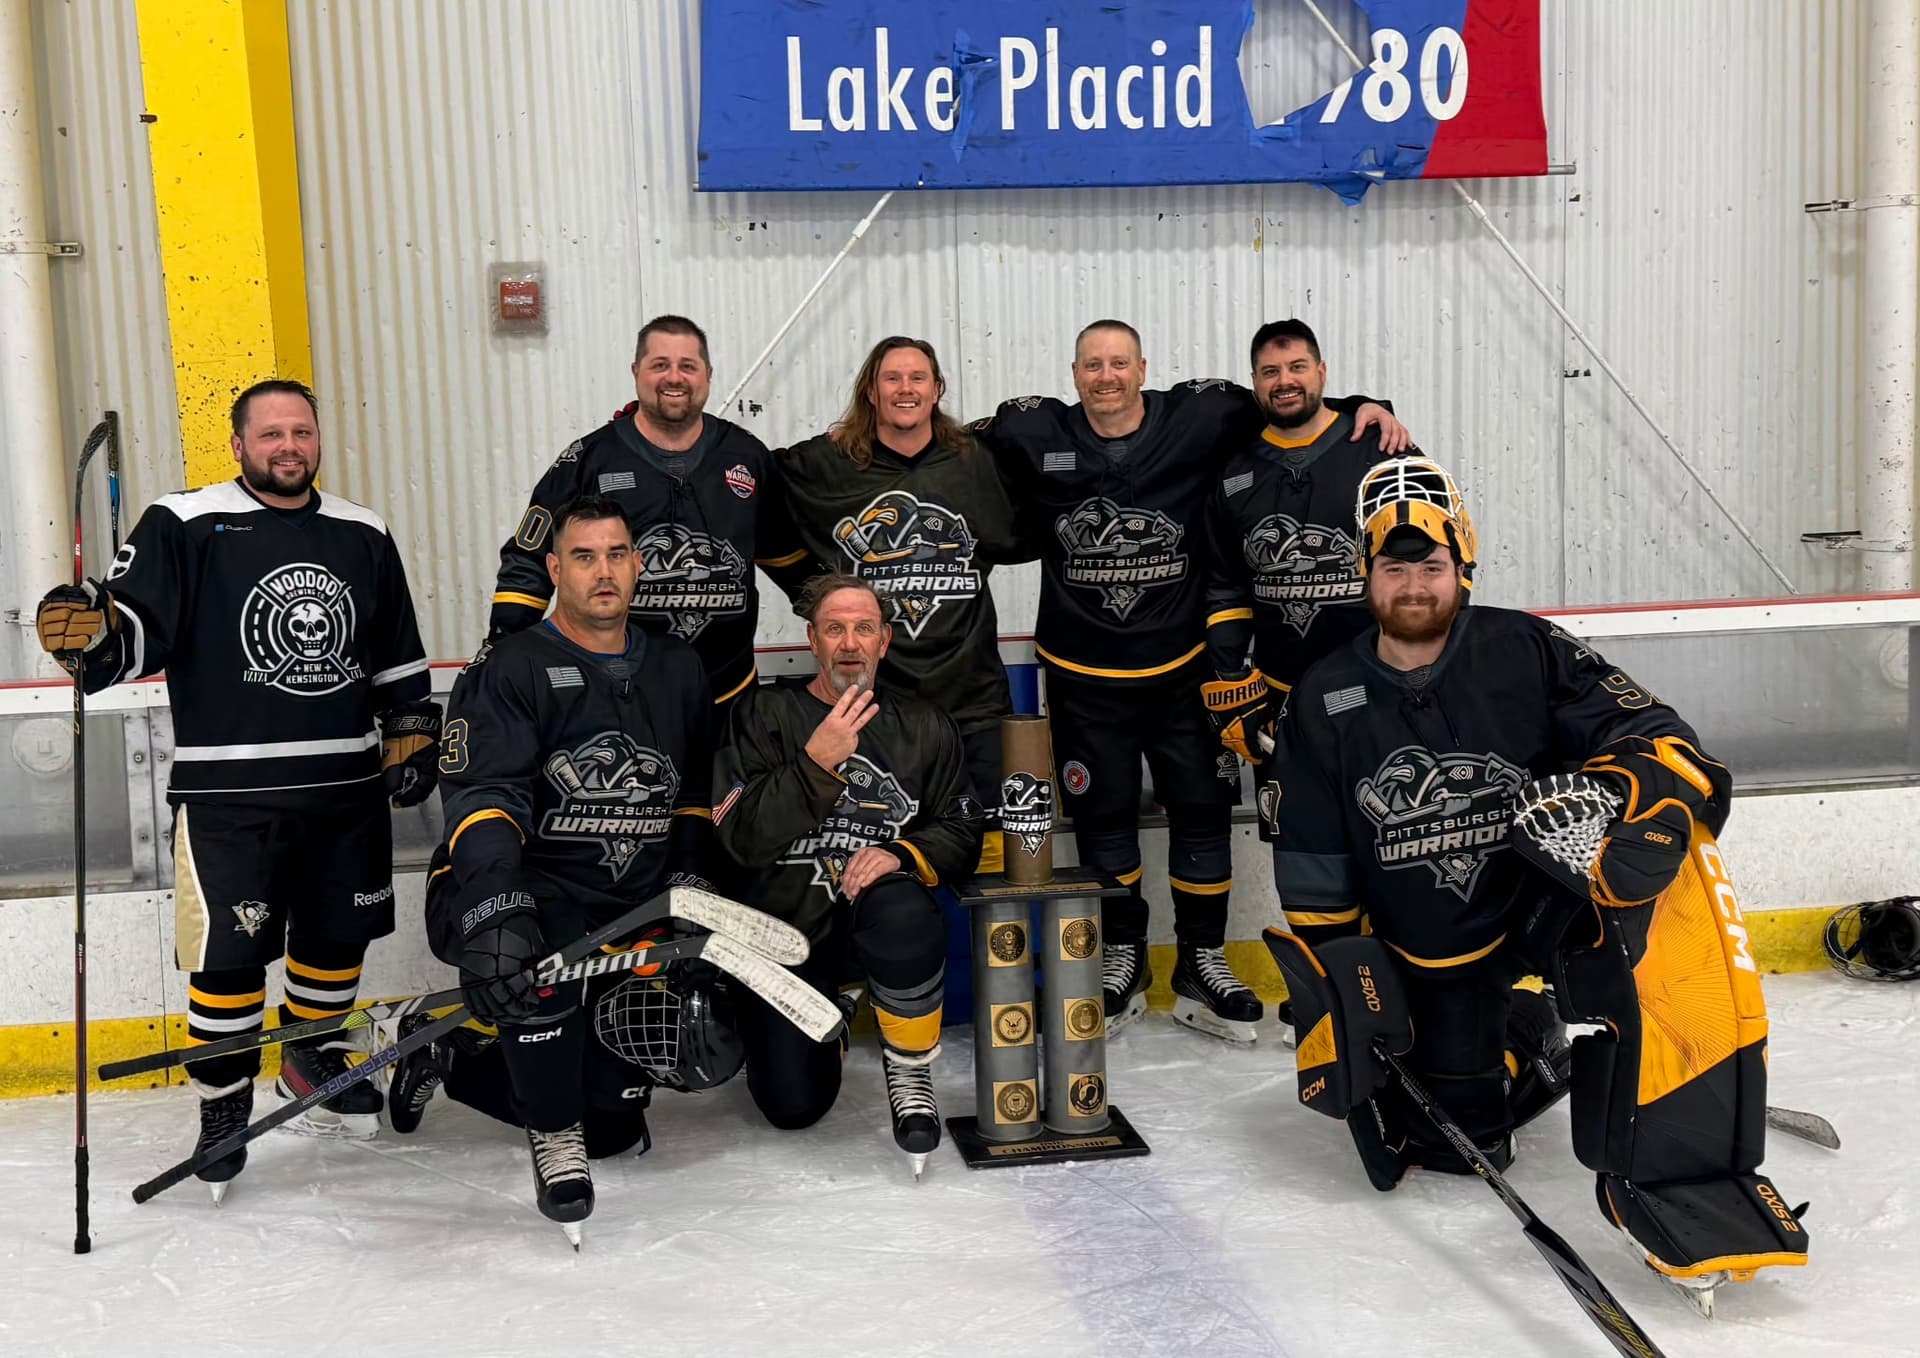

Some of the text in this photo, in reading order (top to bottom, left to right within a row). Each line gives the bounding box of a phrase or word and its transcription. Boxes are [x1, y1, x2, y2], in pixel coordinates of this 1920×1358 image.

[786, 27, 956, 133] Lake
[1001, 26, 1213, 131] Placid
[1073, 554, 1170, 568] PITTSBURGH
[862, 563, 963, 577] PITTSBURGH
[1067, 561, 1184, 582] WARRIORS
[1260, 572, 1348, 585] PITTSBURGH
[269, 570, 338, 598] VOODOO
[639, 583, 736, 593] PITTSBURGH
[868, 576, 977, 593] ARRIORS
[1254, 581, 1365, 599] WARRIORS
[303, 663, 322, 673] NEW
[286, 673, 340, 684] KENSINGTON
[438, 718, 470, 775] 3
[569, 803, 669, 816] PITTSBURGH
[550, 815, 673, 834] WARRIORS
[1699, 842, 1757, 973] CCM
[518, 1027, 563, 1044] CCM
[1301, 1075, 1326, 1103] CCM
